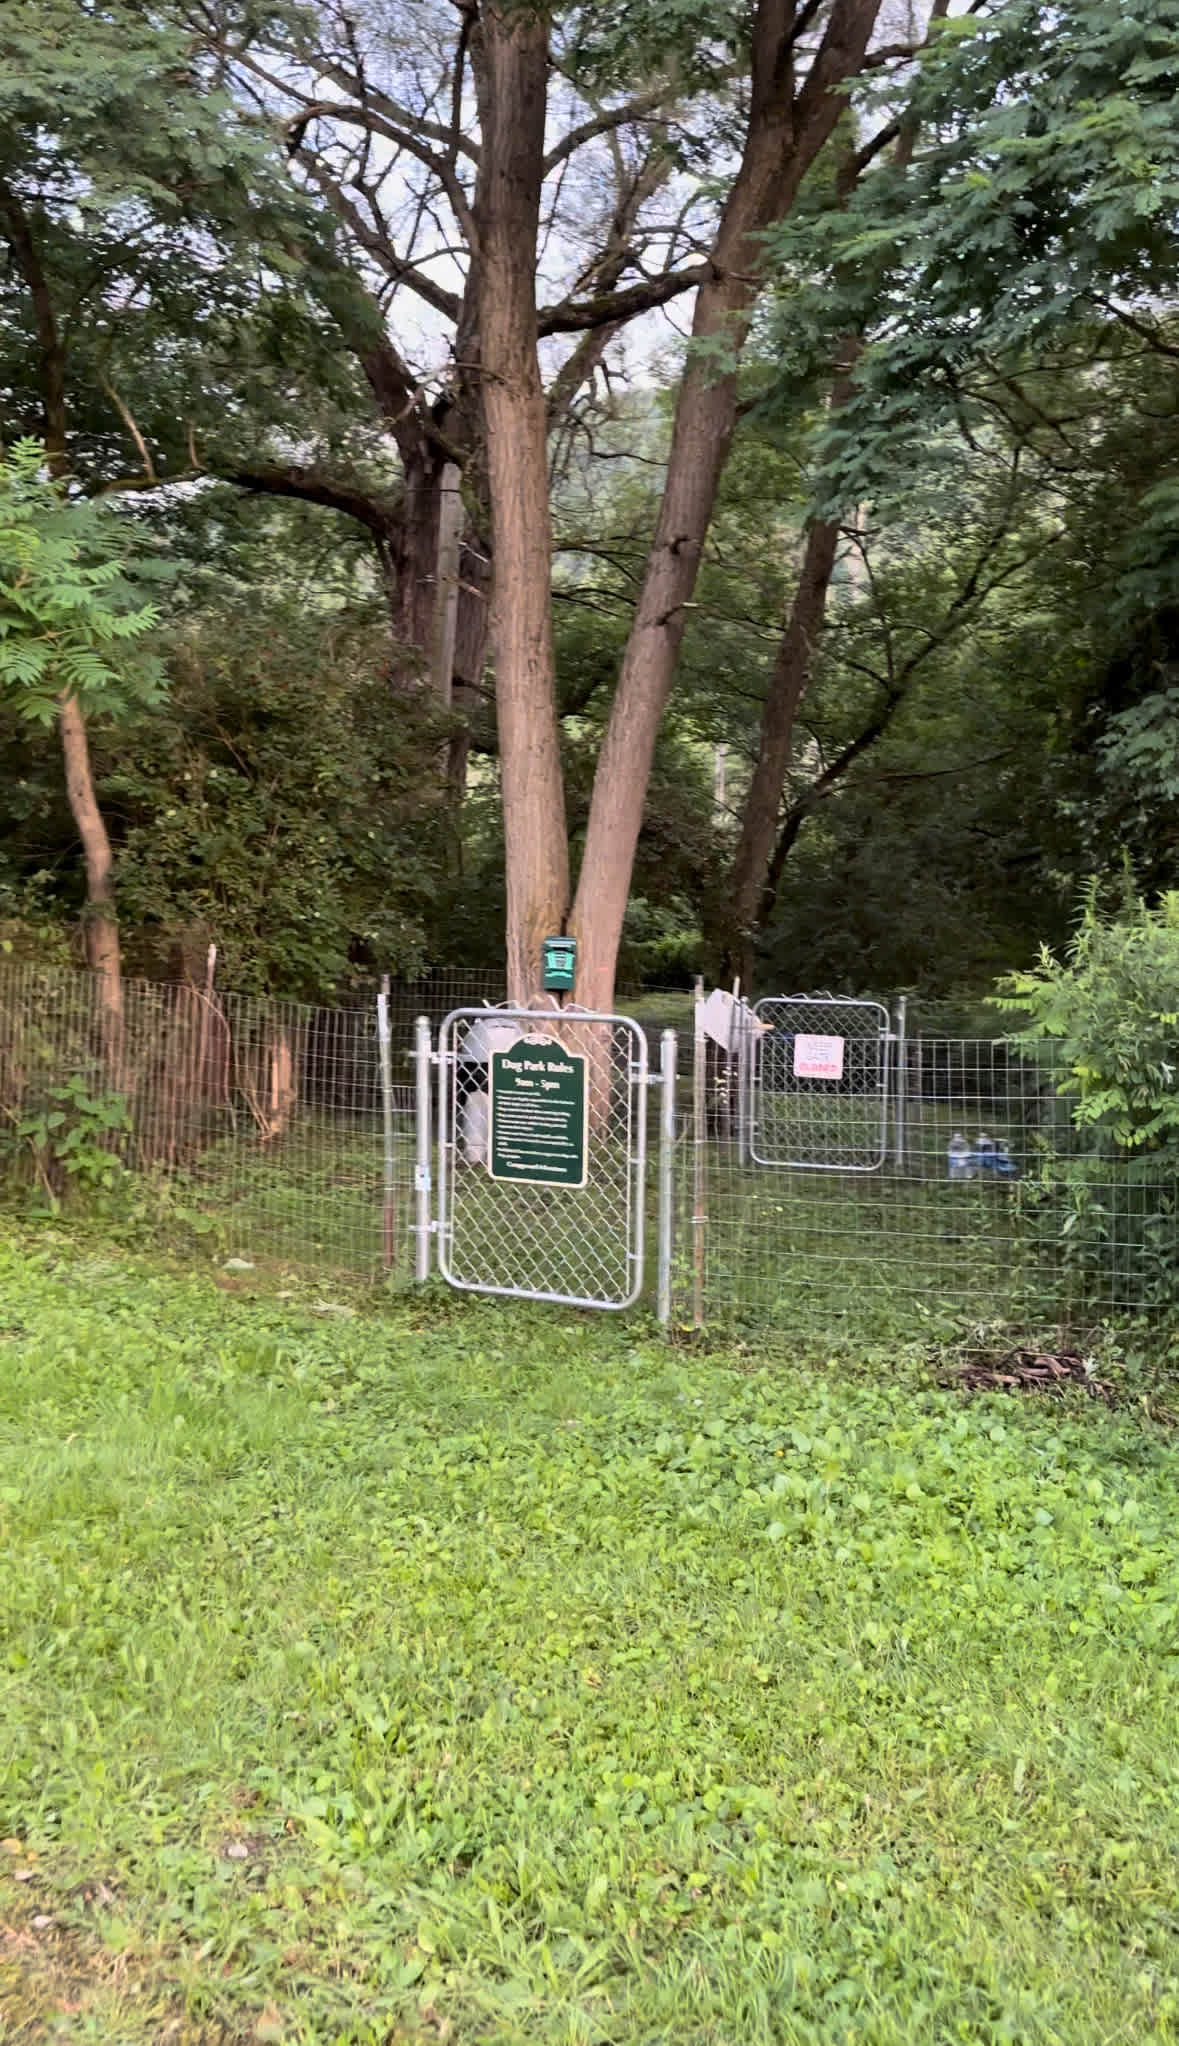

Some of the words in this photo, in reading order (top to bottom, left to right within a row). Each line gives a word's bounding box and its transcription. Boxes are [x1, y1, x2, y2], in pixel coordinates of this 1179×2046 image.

[502, 1059, 523, 1072] Dog
[524, 1060, 546, 1072] Park
[547, 1062, 574, 1073] Rules
